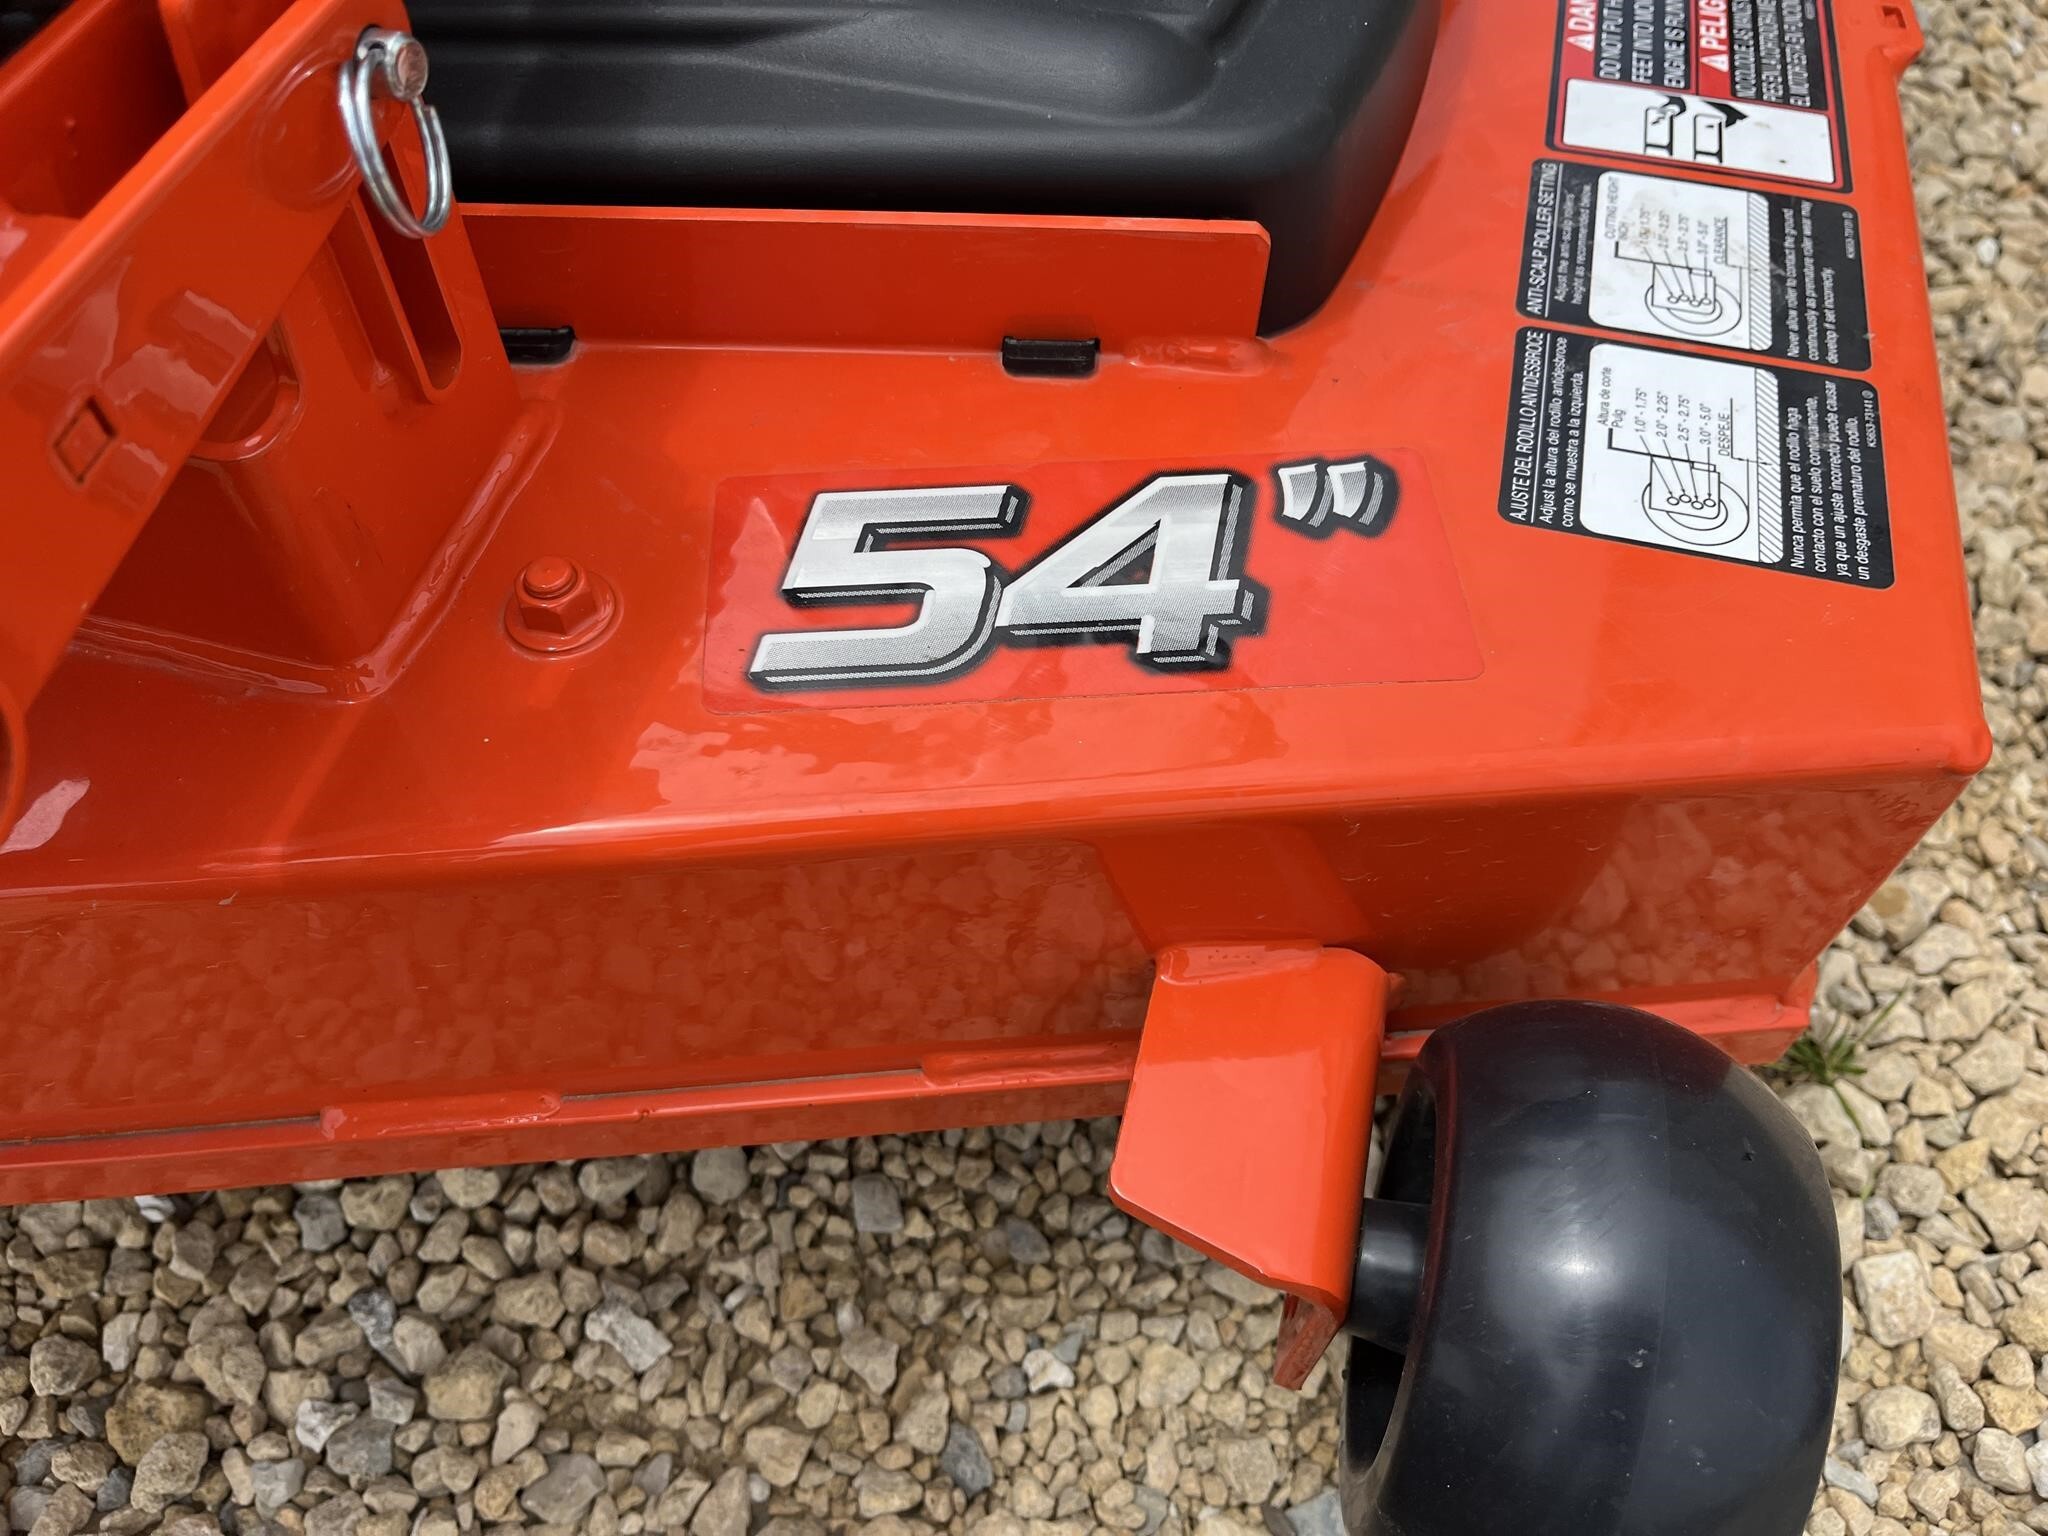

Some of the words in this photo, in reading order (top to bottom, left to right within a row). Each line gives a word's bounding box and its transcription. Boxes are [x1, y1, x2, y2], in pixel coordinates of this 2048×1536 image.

[1602, 8, 1623, 32] PUT
[1601, 32, 1622, 58] NOT
[1633, 22, 1654, 51] INTO
[1664, 28, 1685, 41] IS
[1599, 59, 1621, 80] DO
[1631, 51, 1653, 83] FEET
[1664, 41, 1685, 88] ENGINE
[1790, 96, 1810, 106] EL
[1538, 163, 1557, 206] SETTING
[1607, 176, 1618, 203] HEIGHT
[1800, 201, 1813, 216] may
[1535, 207, 1552, 248] ROLLER
[1605, 206, 1617, 239] CUTTING
[1619, 223, 1628, 240] INCH
[1782, 209, 1797, 235] ground
[1802, 217, 1812, 236] wear
[1559, 219, 1573, 258] anti-scalp
[1575, 208, 1589, 264] recommended
[1714, 217, 1725, 264] CLEARANCE
[1783, 236, 1794, 248] the
[1802, 237, 1813, 255] roller
[1557, 260, 1568, 273] the
[1575, 266, 1585, 275] as
[1785, 249, 1797, 277] contact
[1528, 250, 1549, 314] ANTI-SCALP
[1555, 275, 1568, 301] Adjust
[1786, 278, 1797, 286] to
[1803, 257, 1818, 297] premature
[1572, 277, 1585, 304] height
[1786, 288, 1797, 309] roller
[1806, 298, 1816, 308] as
[1787, 310, 1798, 330] allow
[1823, 310, 1836, 322] set
[1788, 332, 1800, 357] Never
[1805, 310, 1819, 360] continuously
[1826, 331, 1839, 363] develop
[1522, 331, 1543, 407] ANTIDESBROCE
[1552, 337, 1567, 396] antidesbroce
[1600, 367, 1611, 386] corte
[1568, 371, 1584, 416] izquierda.
[1598, 389, 1610, 400] de
[1824, 381, 1837, 411] causar
[1549, 398, 1562, 427] rodillo
[1567, 418, 1579, 427] la
[1598, 402, 1610, 426] Altura
[1785, 407, 1799, 430] haga
[1516, 407, 1536, 453] RODILLO
[1547, 430, 1559, 444] del
[1718, 413, 1730, 456] DESPEJE
[1806, 396, 1821, 465] continuamente,
[1826, 413, 1842, 442] puede
[1845, 417, 1858, 446] rodillo.
[1787, 432, 1799, 460] rodillo
[1847, 448, 1860, 463] del
[1514, 455, 1532, 476] DEL
[1545, 448, 1559, 476] altura
[1566, 439, 1579, 480] muestra
[1788, 462, 1801, 472] el
[1828, 444, 1843, 490] incorrecto
[1542, 478, 1555, 488] la
[1564, 482, 1575, 495] se
[1788, 475, 1804, 493] que
[1809, 468, 1822, 493] suelo
[1850, 466, 1868, 515] prematuro
[1510, 479, 1530, 520] AJUSTE
[1539, 490, 1556, 523] Adjust
[1562, 497, 1575, 527] como
[1810, 495, 1823, 505] el
[1830, 492, 1848, 523] ajuste
[1789, 495, 1806, 533] permita
[1811, 507, 1824, 526] con
[1833, 526, 1845, 538] un
[1853, 517, 1871, 564] desgaste
[1790, 535, 1805, 568] Nunca
[1811, 528, 1827, 572] contacto
[1834, 540, 1849, 560] que
[1834, 563, 1852, 576] ya
[1857, 567, 1870, 580] un
